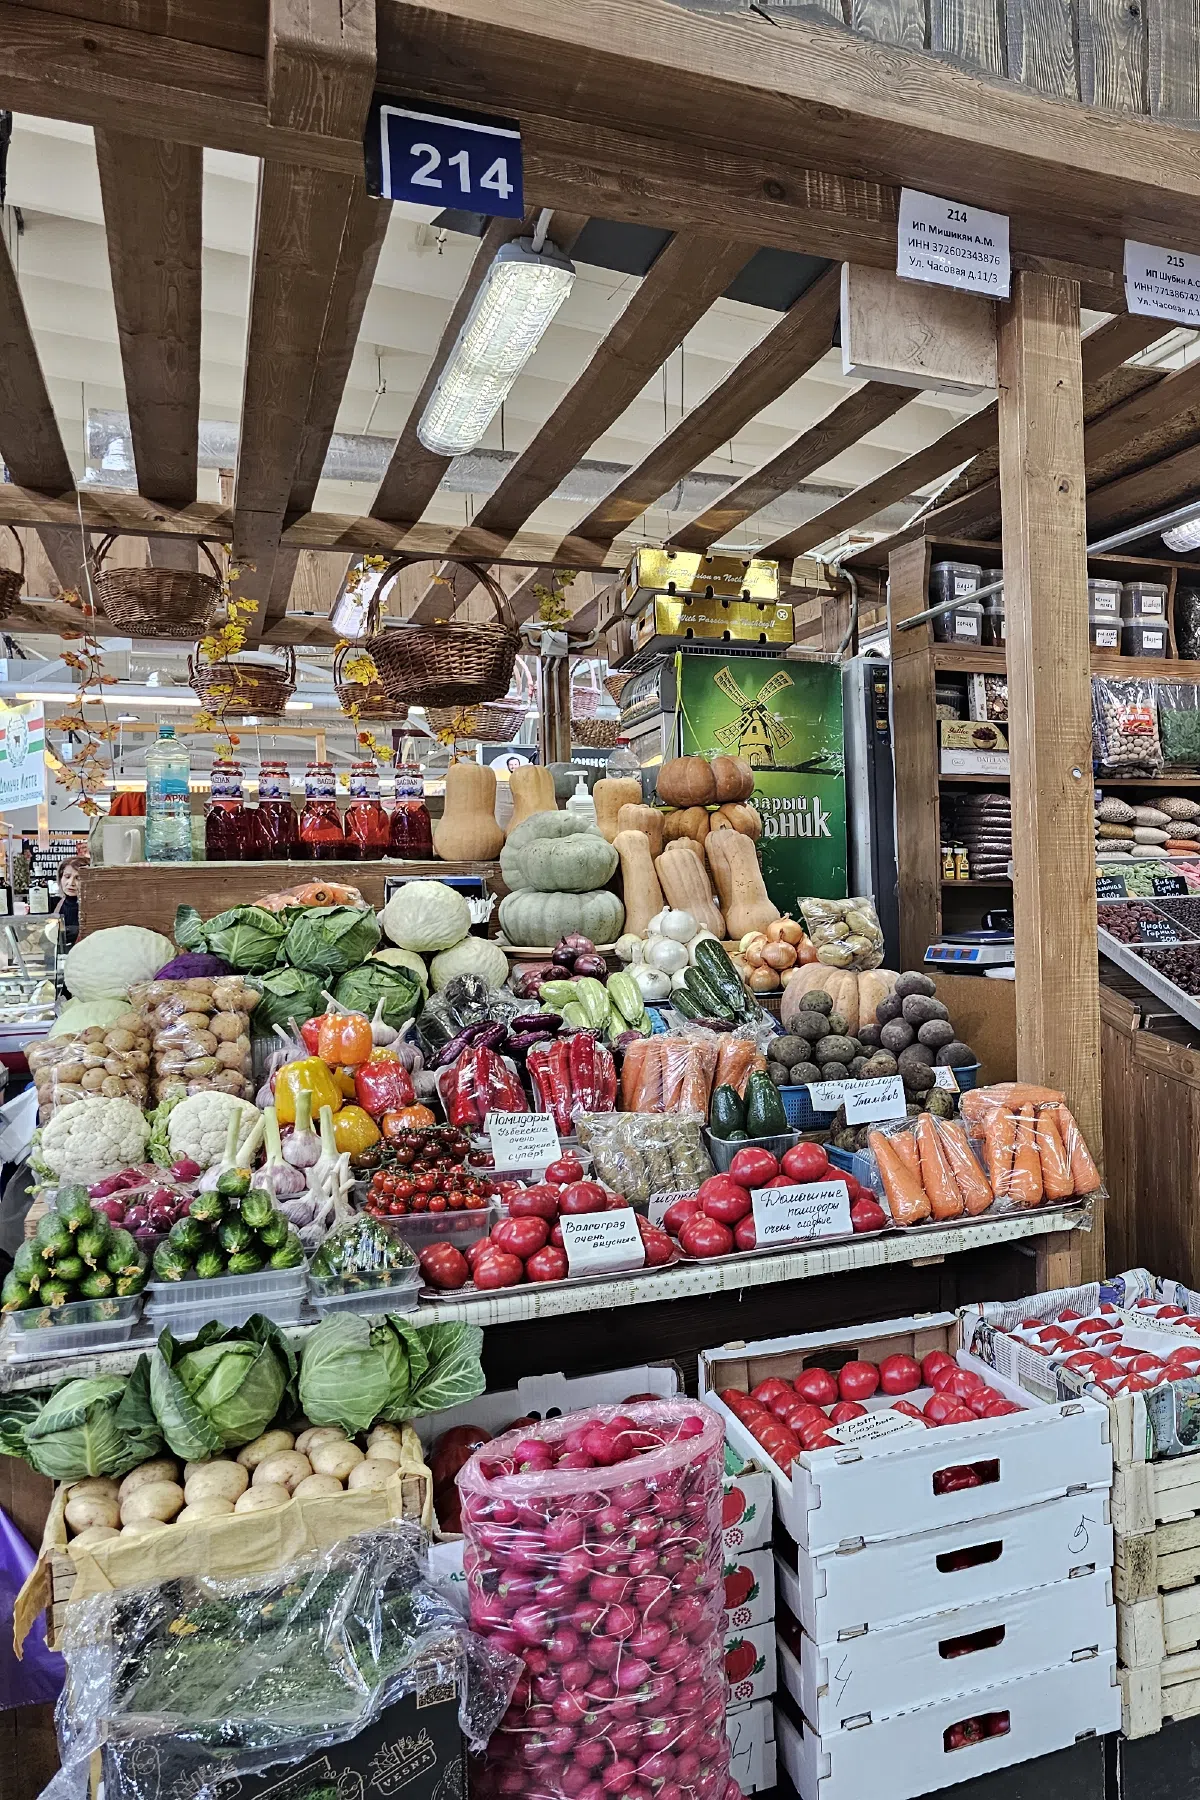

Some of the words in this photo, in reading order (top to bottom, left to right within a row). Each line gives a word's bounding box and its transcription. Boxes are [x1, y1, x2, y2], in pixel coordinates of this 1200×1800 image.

[410, 143, 514, 199] 214
[947, 209, 967, 223] 214
[912, 221, 925, 232] ИП
[928, 225, 973, 242] Мишикян
[908, 238, 930, 250] ИНН
[909, 256, 924, 268] Ул.
[927, 260, 966, 276] Часовая
[1167, 255, 1185, 268] 215
[1146, 269, 1157, 279] ИП
[1160, 272, 1186, 285] Шубин
[1134, 281, 1153, 293] ИНН
[1137, 296, 1151, 306] Ул.
[1152, 300, 1186, 313] Часовая
[489, 1113, 550, 1127] Помидоры
[761, 1189, 843, 1207] Домашние
[566, 1221, 626, 1233] Волгоград
[765, 1223, 791, 1234] очень
[574, 1234, 605, 1243] очень
[593, 1236, 636, 1248] вкусные
[383, 1753, 431, 1787] VESNA
